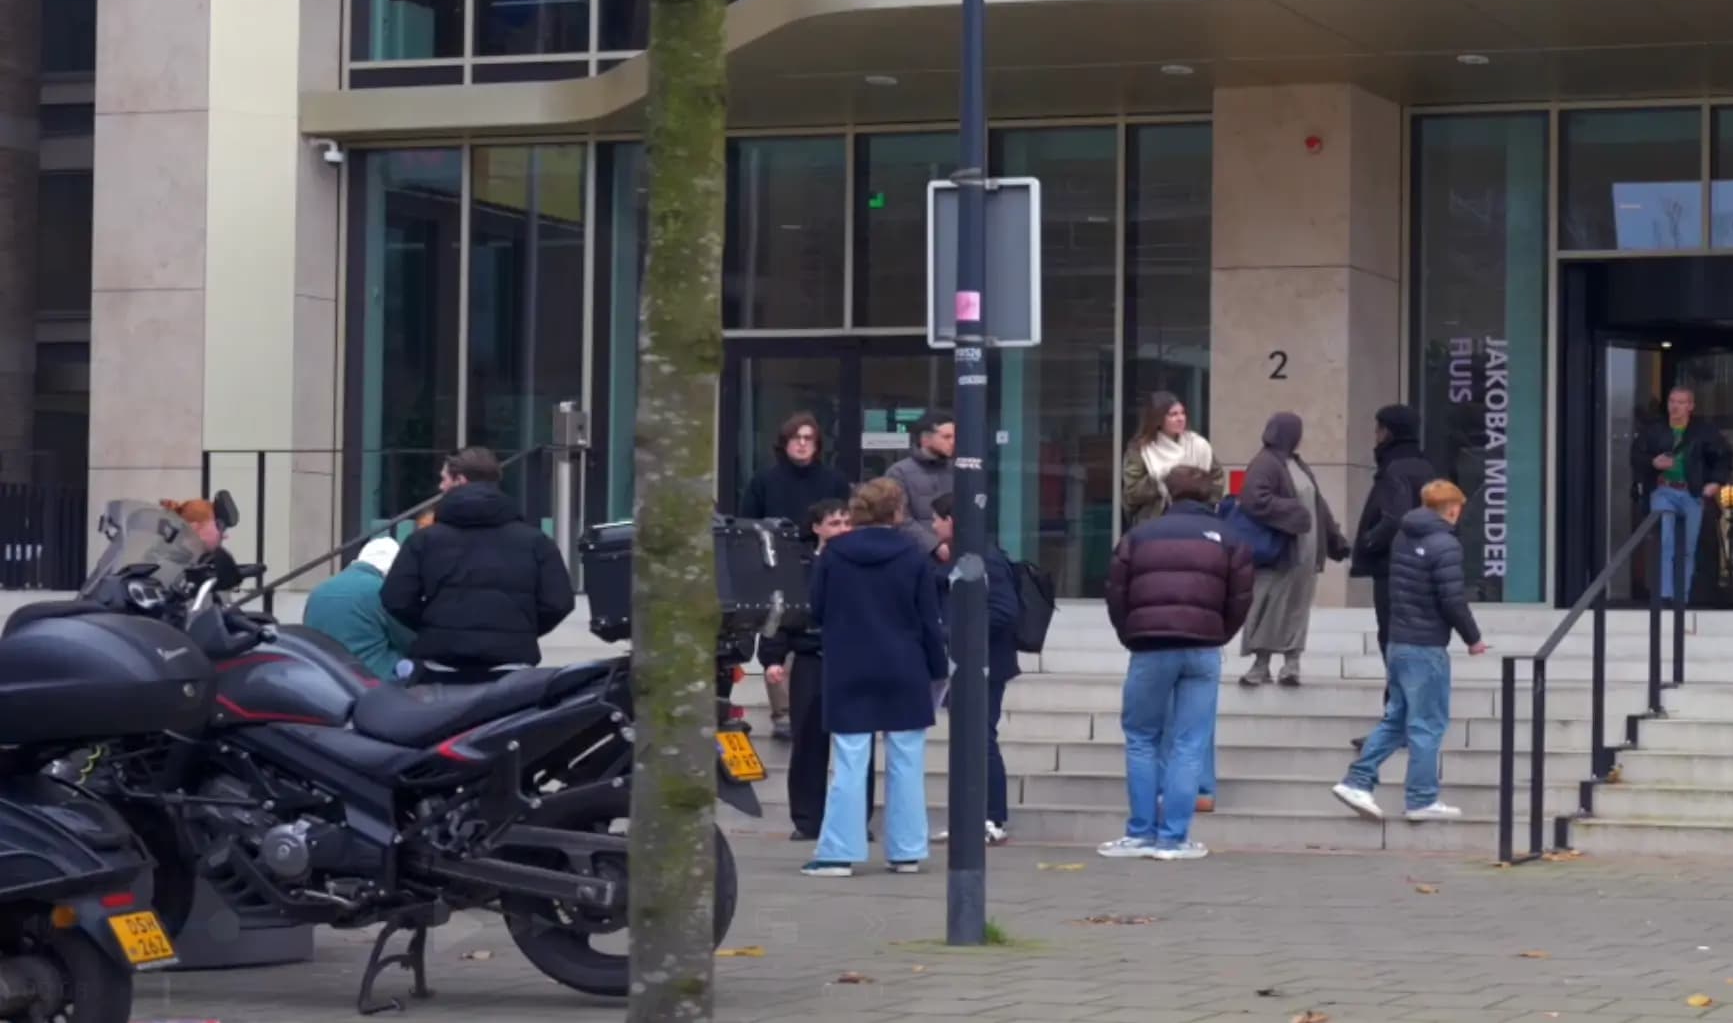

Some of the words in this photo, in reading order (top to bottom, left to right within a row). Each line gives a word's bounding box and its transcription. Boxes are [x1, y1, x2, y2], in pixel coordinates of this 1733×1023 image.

[1268, 350, 1288, 380] 2
[1448, 337, 1473, 404] HUIS
[1483, 335, 1509, 450] JAKOBA
[1483, 459, 1509, 578] MULDER
